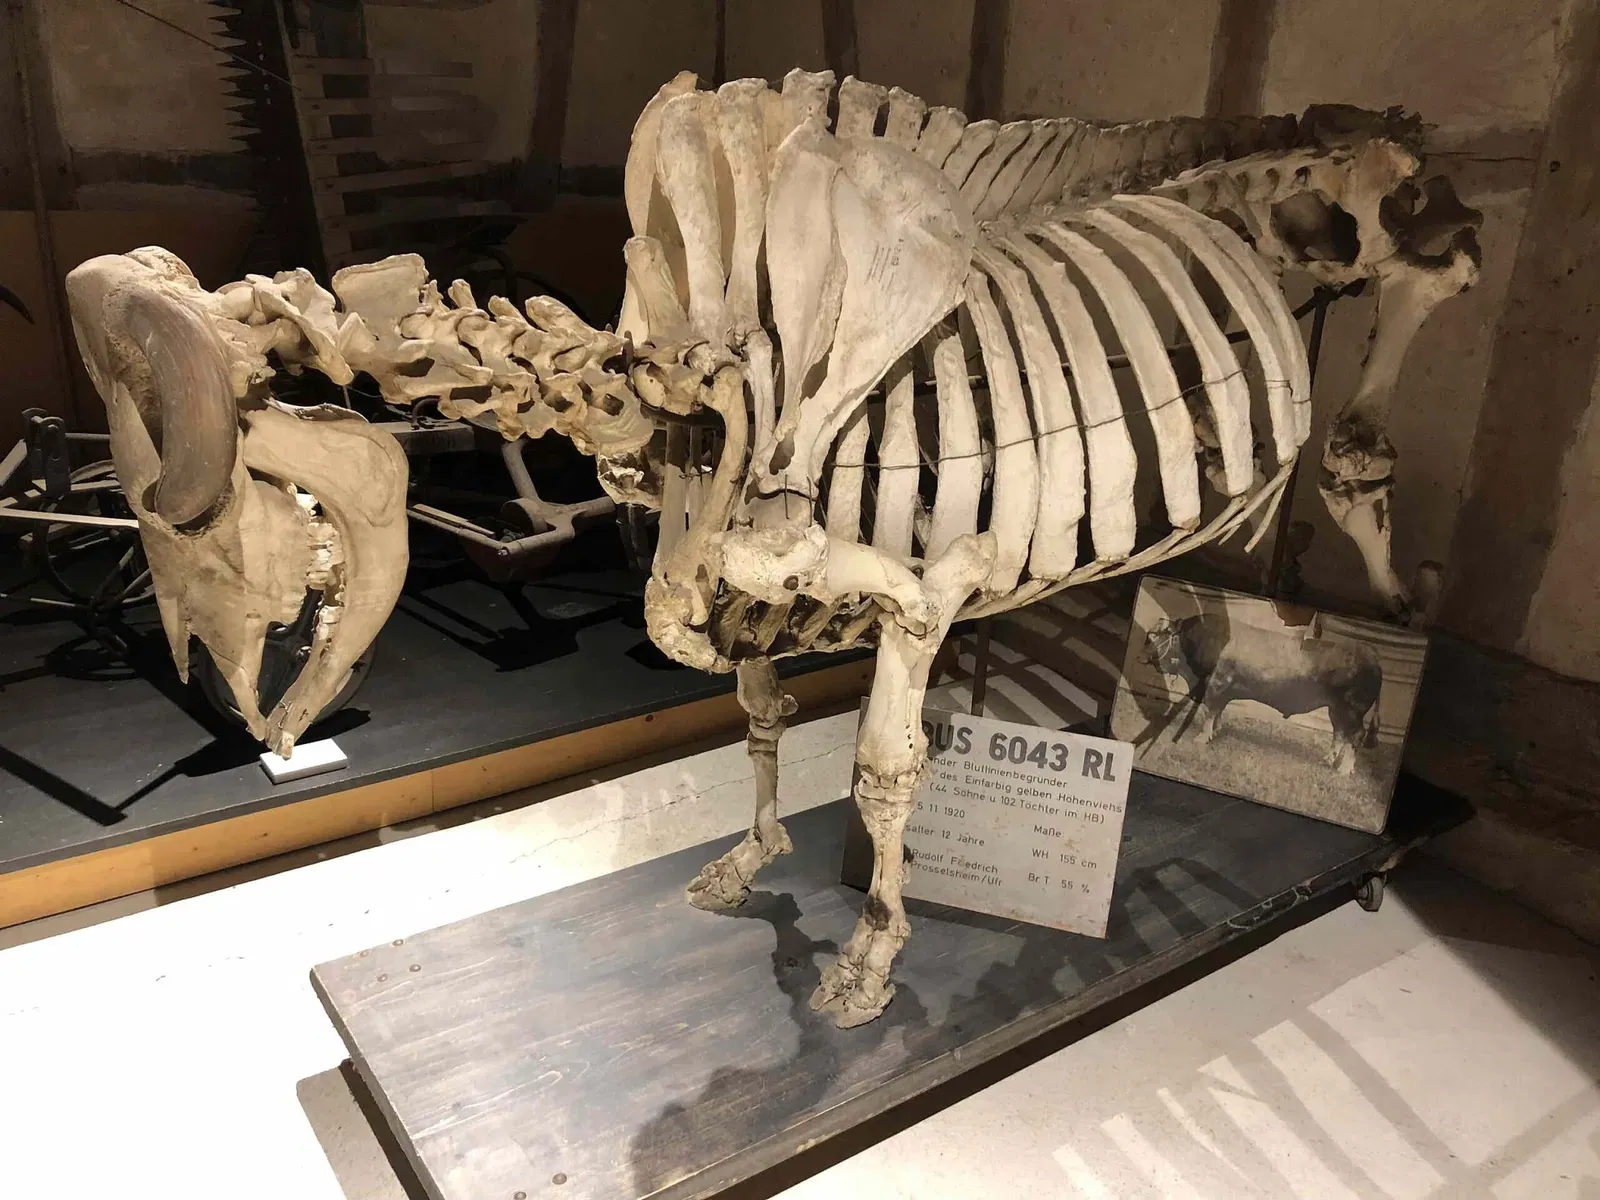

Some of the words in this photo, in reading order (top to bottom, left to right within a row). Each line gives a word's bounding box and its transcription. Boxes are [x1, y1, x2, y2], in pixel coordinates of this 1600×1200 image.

[989, 732, 1069, 771] 6043
[1081, 747, 1116, 782] RL
[939, 771, 958, 782] des
[965, 775, 1012, 793] Einfarbig
[1016, 786, 1052, 800] gelben
[944, 806, 966, 819] 1920
[1001, 795, 1017, 807] 102
[1064, 810, 1078, 819] im
[1083, 811, 1105, 824] HB)
[942, 829, 952, 840] 12
[956, 832, 986, 847] Jahre
[911, 848, 945, 862] Rudolf
[1031, 847, 1050, 860] WH
[1060, 853, 1077, 865] 155
[1081, 859, 1098, 869] cm
[1061, 879, 1074, 890] 55
[1081, 883, 1091, 894] %
